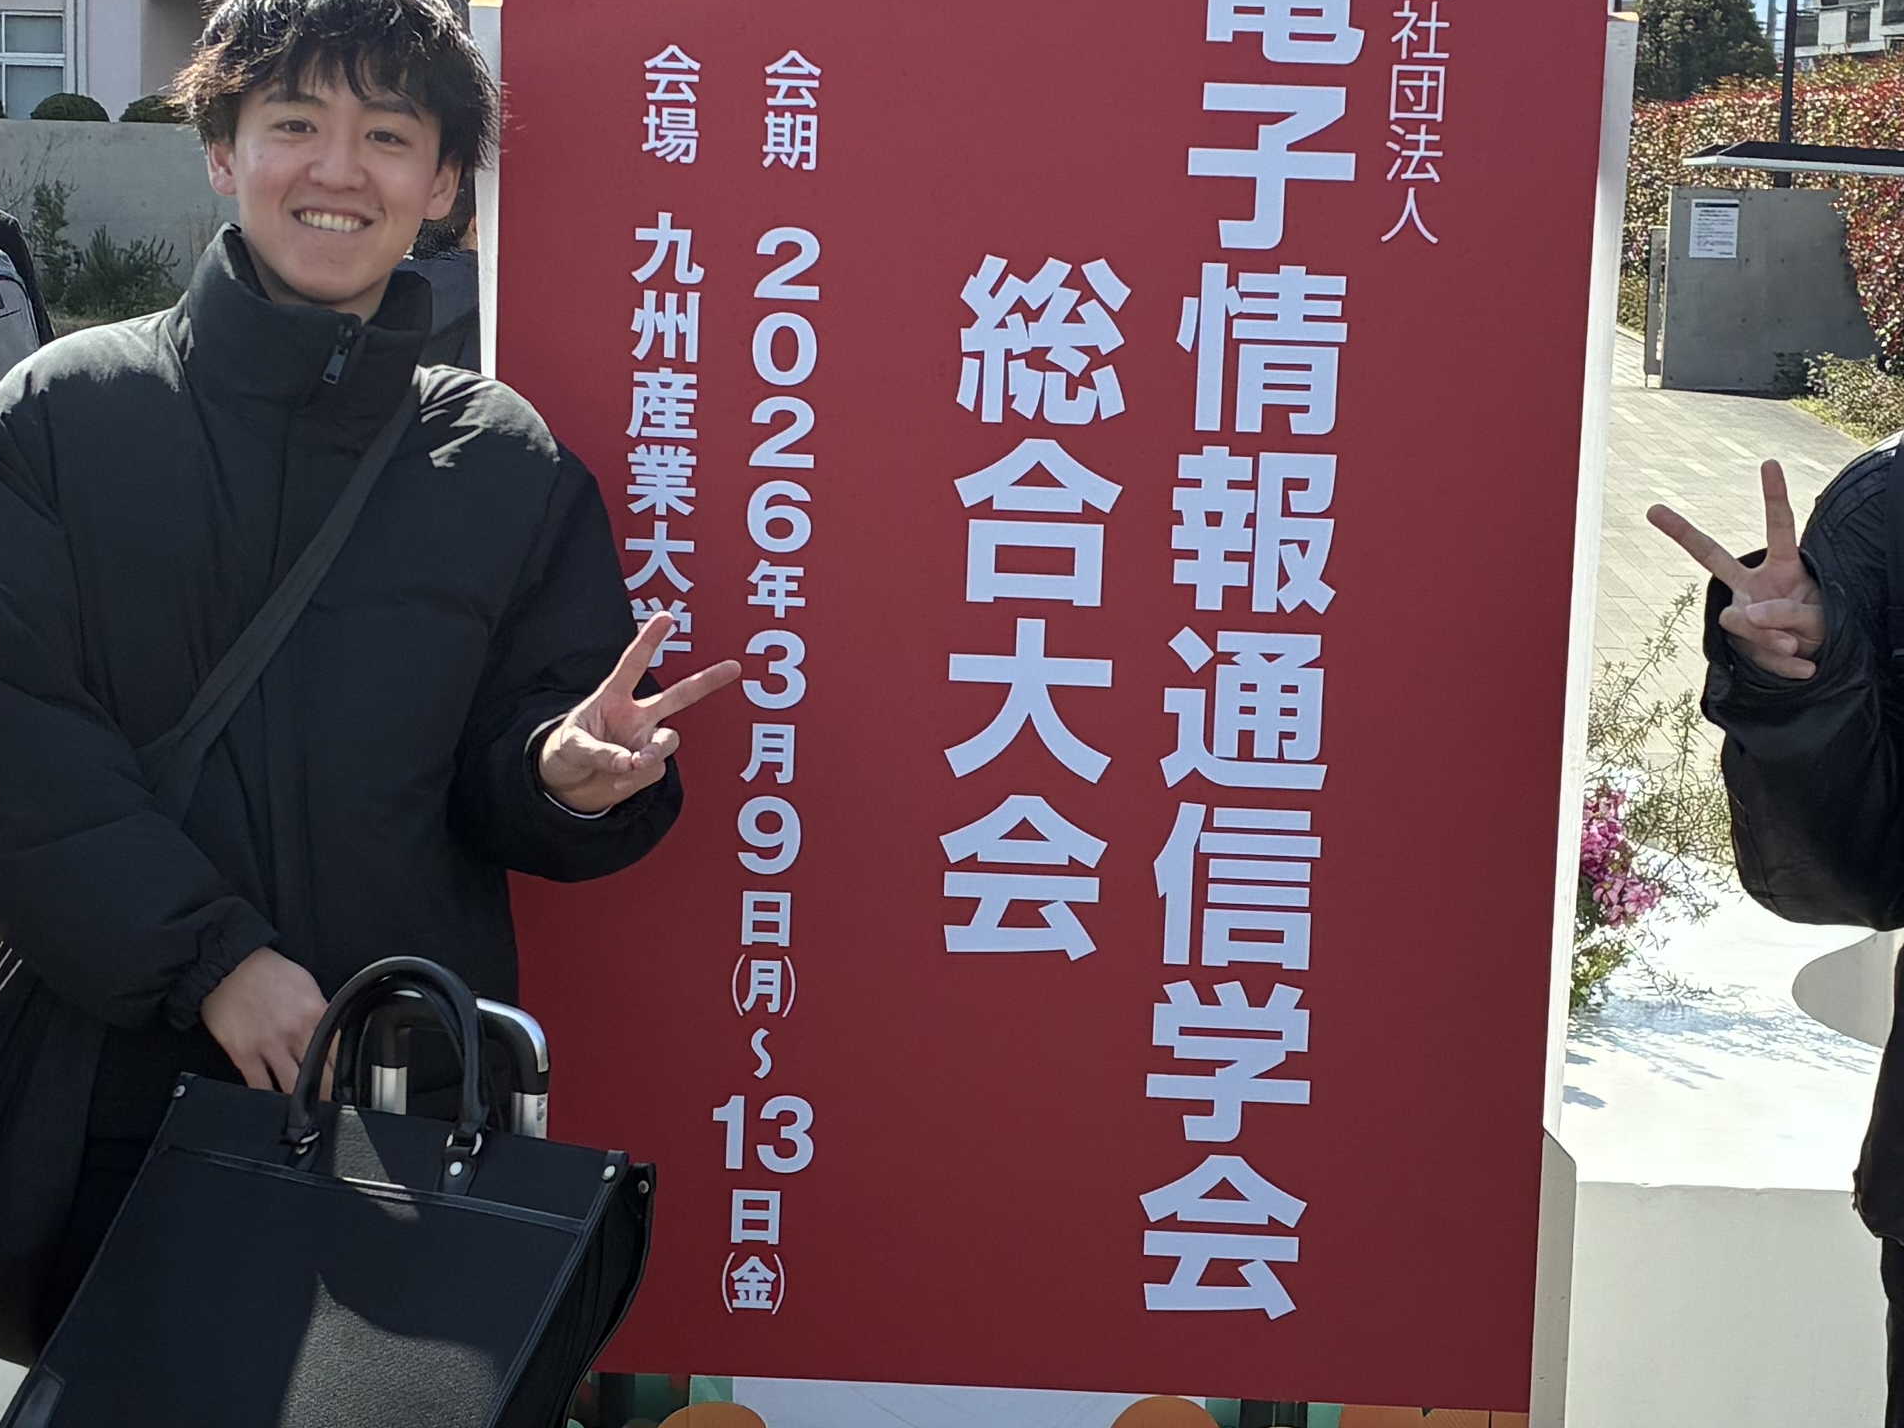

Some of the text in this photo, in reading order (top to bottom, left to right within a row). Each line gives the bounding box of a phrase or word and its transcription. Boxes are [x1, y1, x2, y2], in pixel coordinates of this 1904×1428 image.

[641, 44, 702, 164] 会場
[762, 49, 822, 171] 会期
[939, 253, 1132, 961] 総合大会
